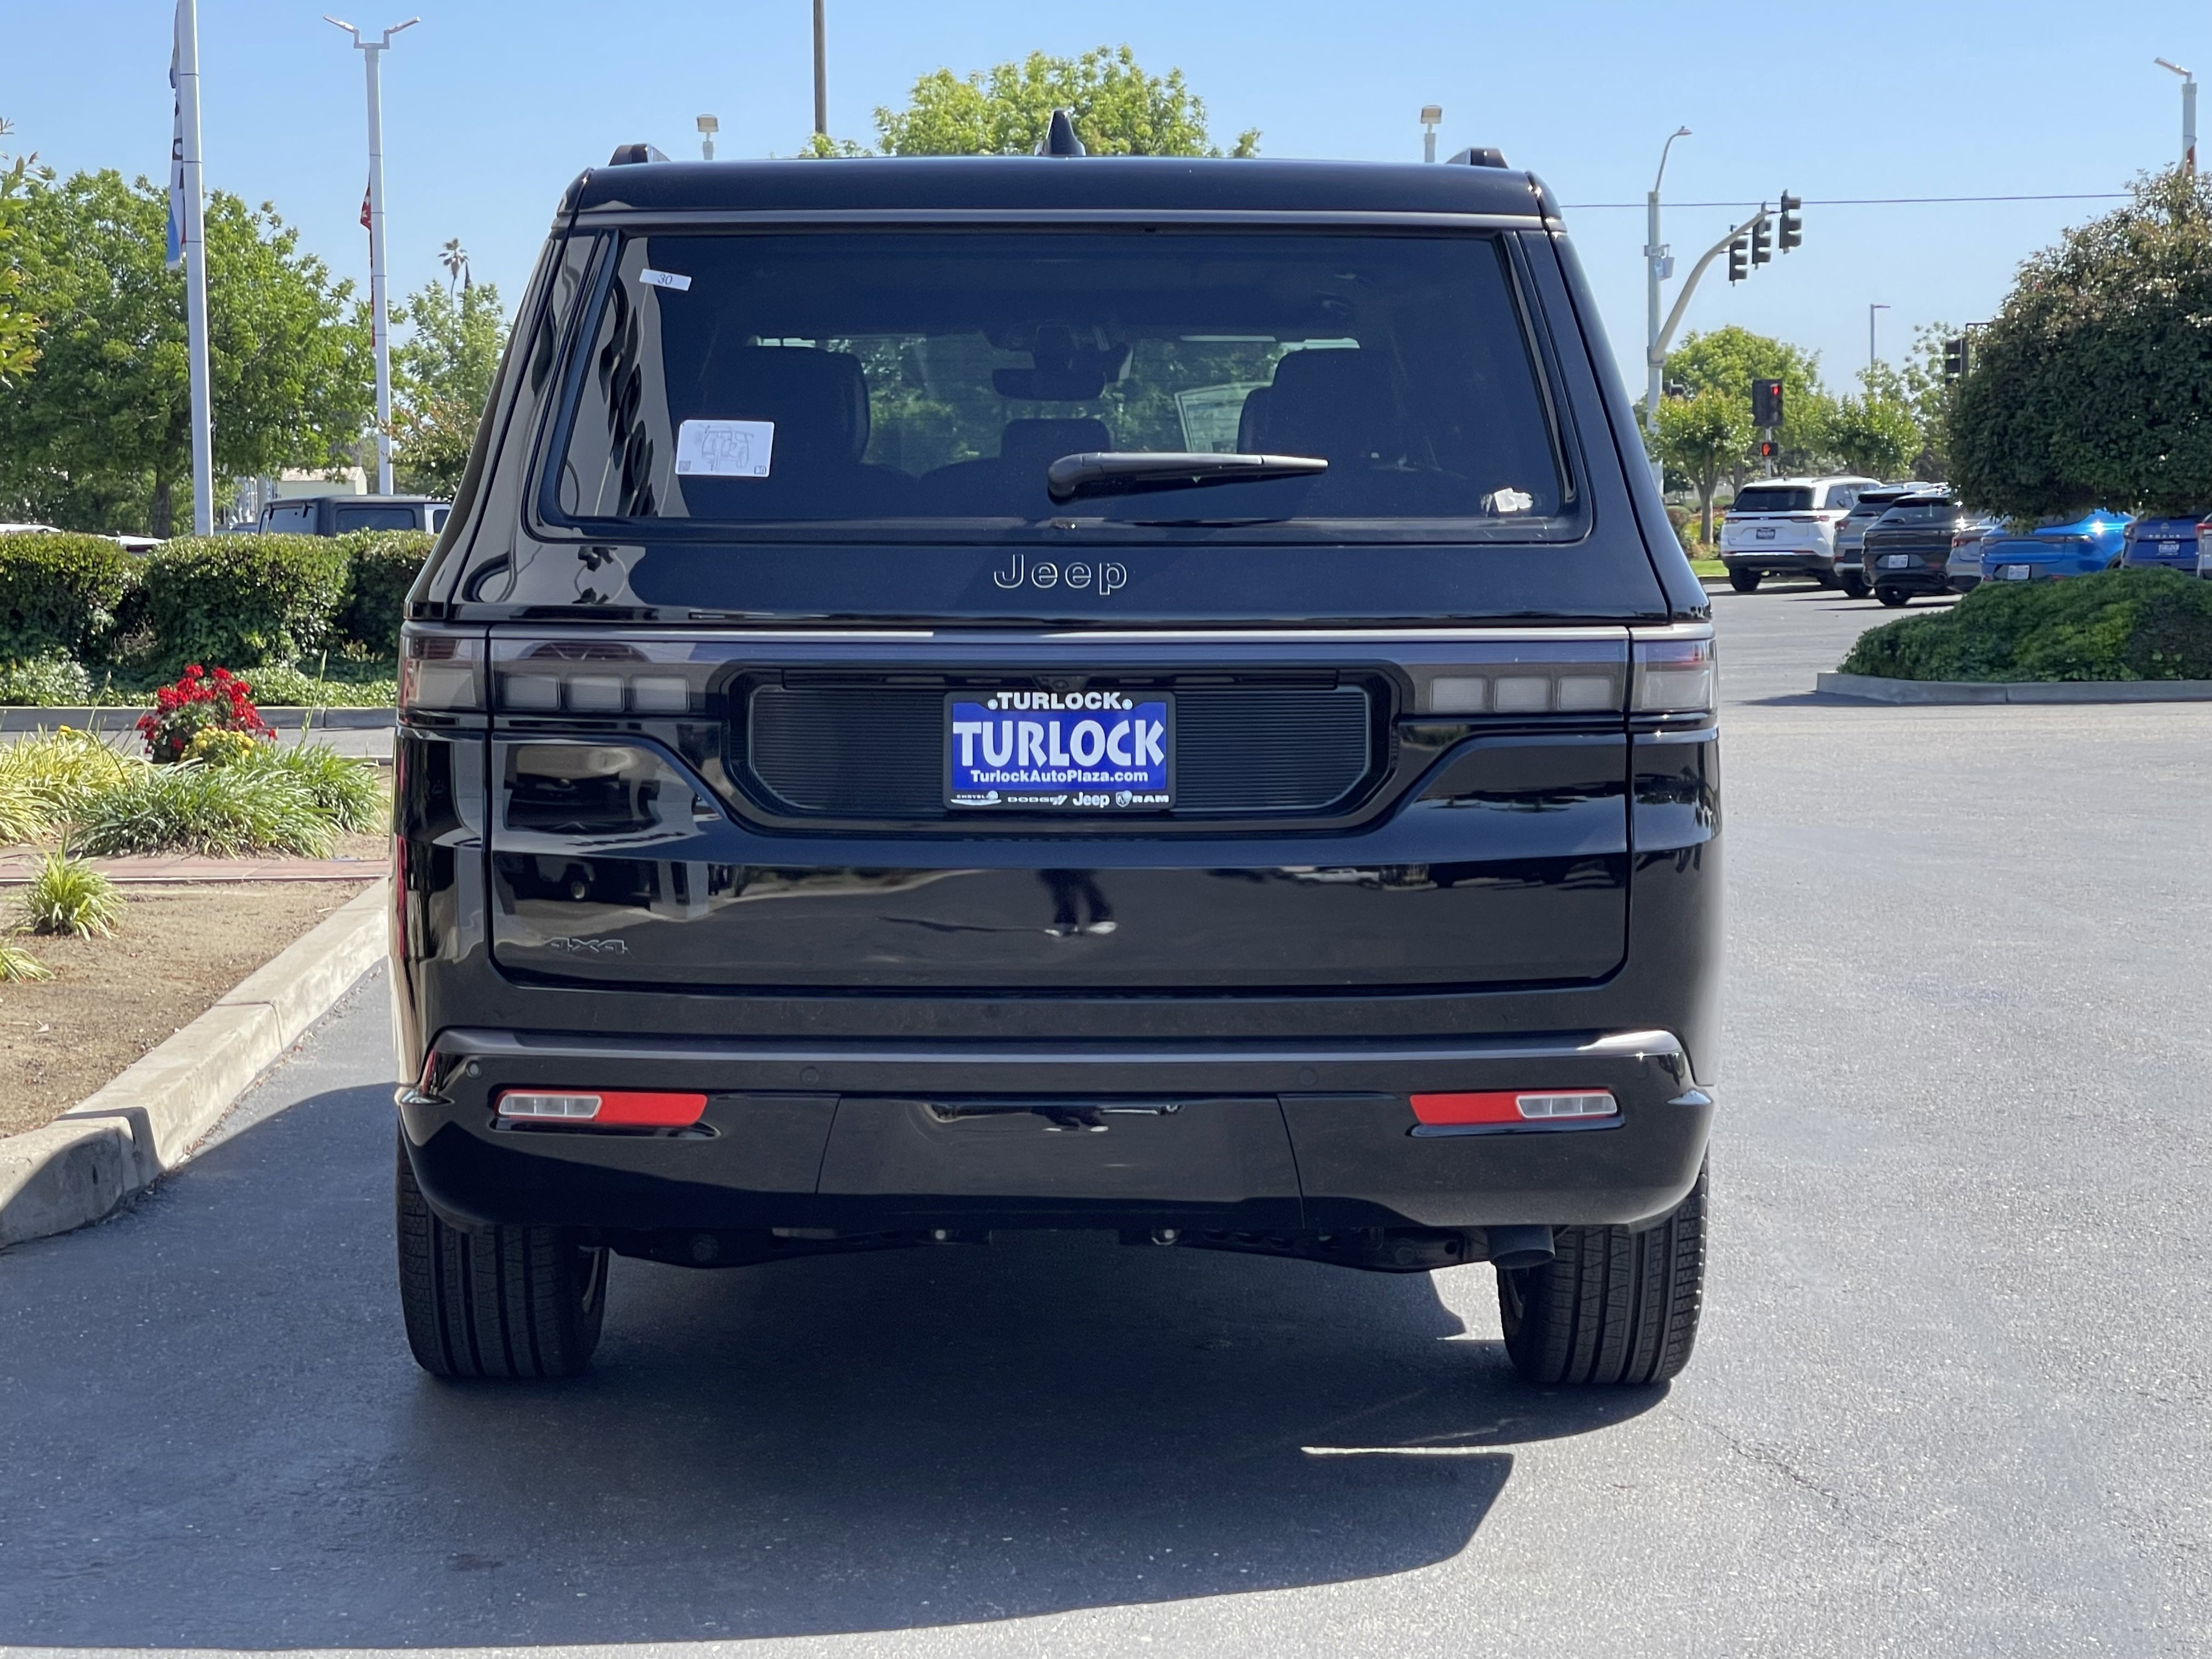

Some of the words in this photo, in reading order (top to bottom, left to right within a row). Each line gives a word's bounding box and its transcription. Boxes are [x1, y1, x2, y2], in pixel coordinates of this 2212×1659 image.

[994, 554, 1127, 596] Jeep
[997, 692, 1122, 710] TURLOCK
[953, 719, 1165, 768] TURLOCK
[970, 770, 1149, 783] TurlockAutoPlaza.com
[1073, 792, 1110, 808] Jeep
[1132, 795, 1170, 803] RAM
